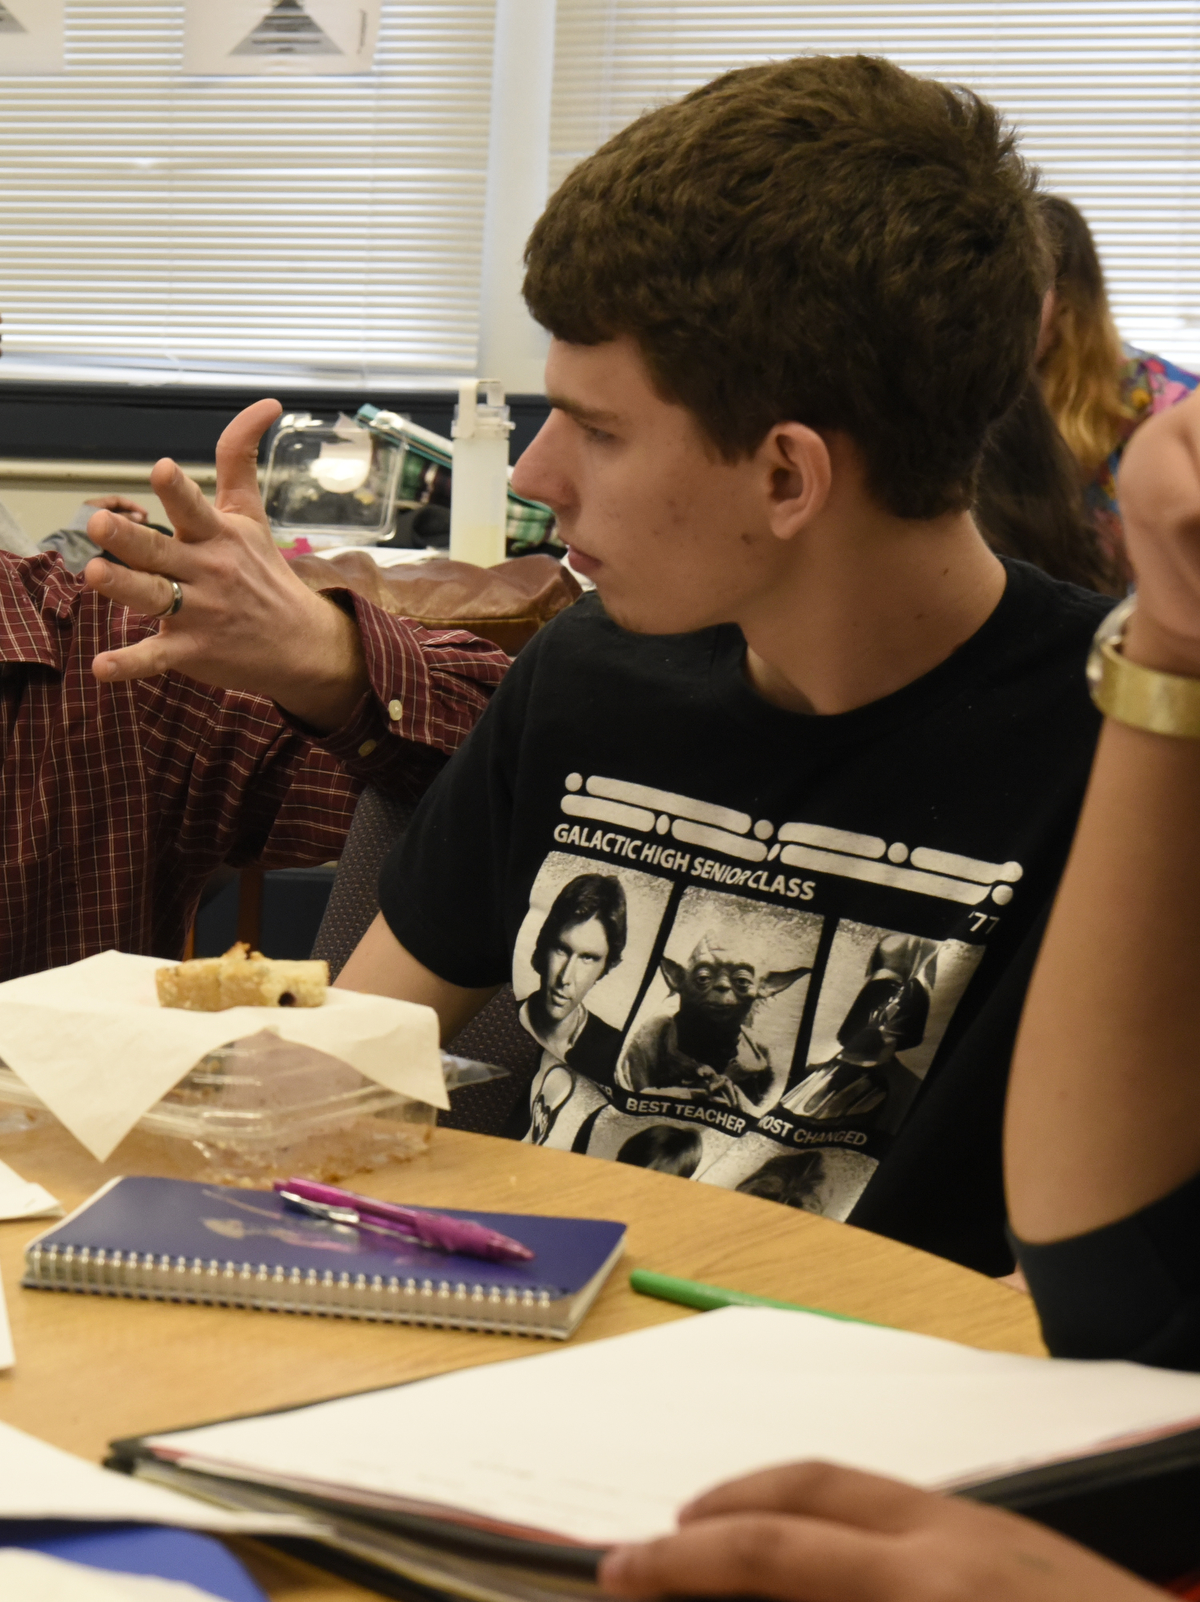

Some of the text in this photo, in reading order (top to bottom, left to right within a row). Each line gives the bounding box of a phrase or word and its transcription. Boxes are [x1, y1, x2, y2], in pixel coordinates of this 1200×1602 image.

[553, 823, 817, 901] GALACTIC HIGH SENIOR CLASS
[625, 1097, 747, 1134] BEST TEACHER
[793, 1128, 868, 1146] CHANGED
